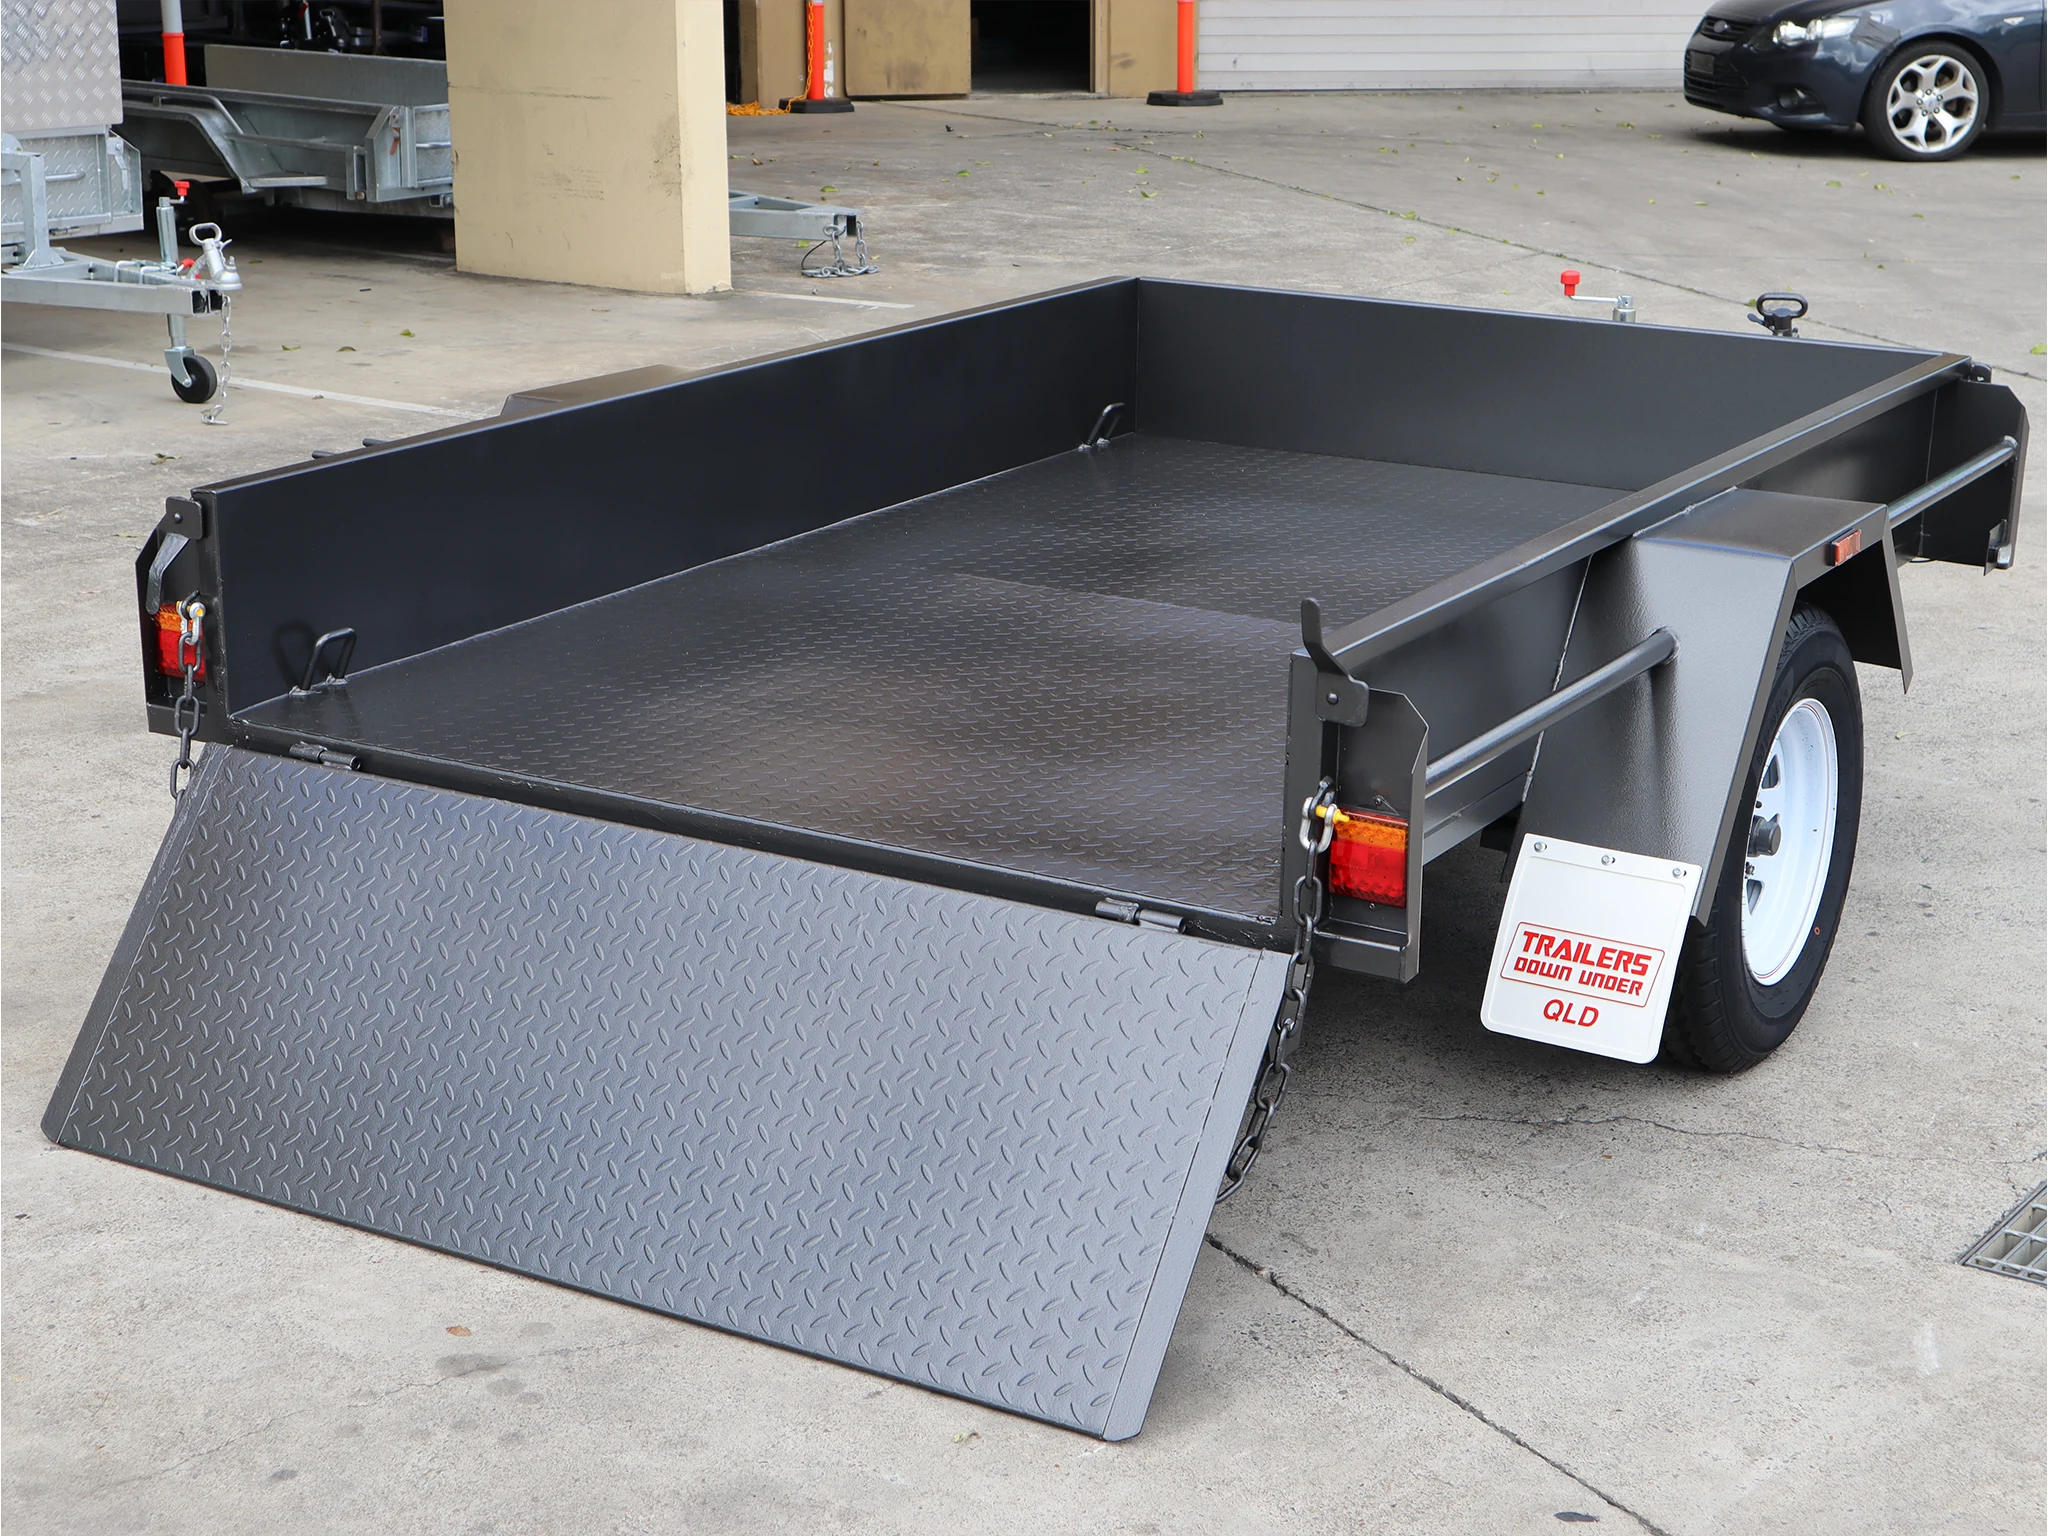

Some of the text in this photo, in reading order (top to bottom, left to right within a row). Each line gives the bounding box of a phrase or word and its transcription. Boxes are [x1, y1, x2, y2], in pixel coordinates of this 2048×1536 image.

[1523, 931, 1652, 976] TRAILERS
[1513, 956, 1643, 996] DOWN UNDER
[1543, 998, 1599, 1027] QLD
